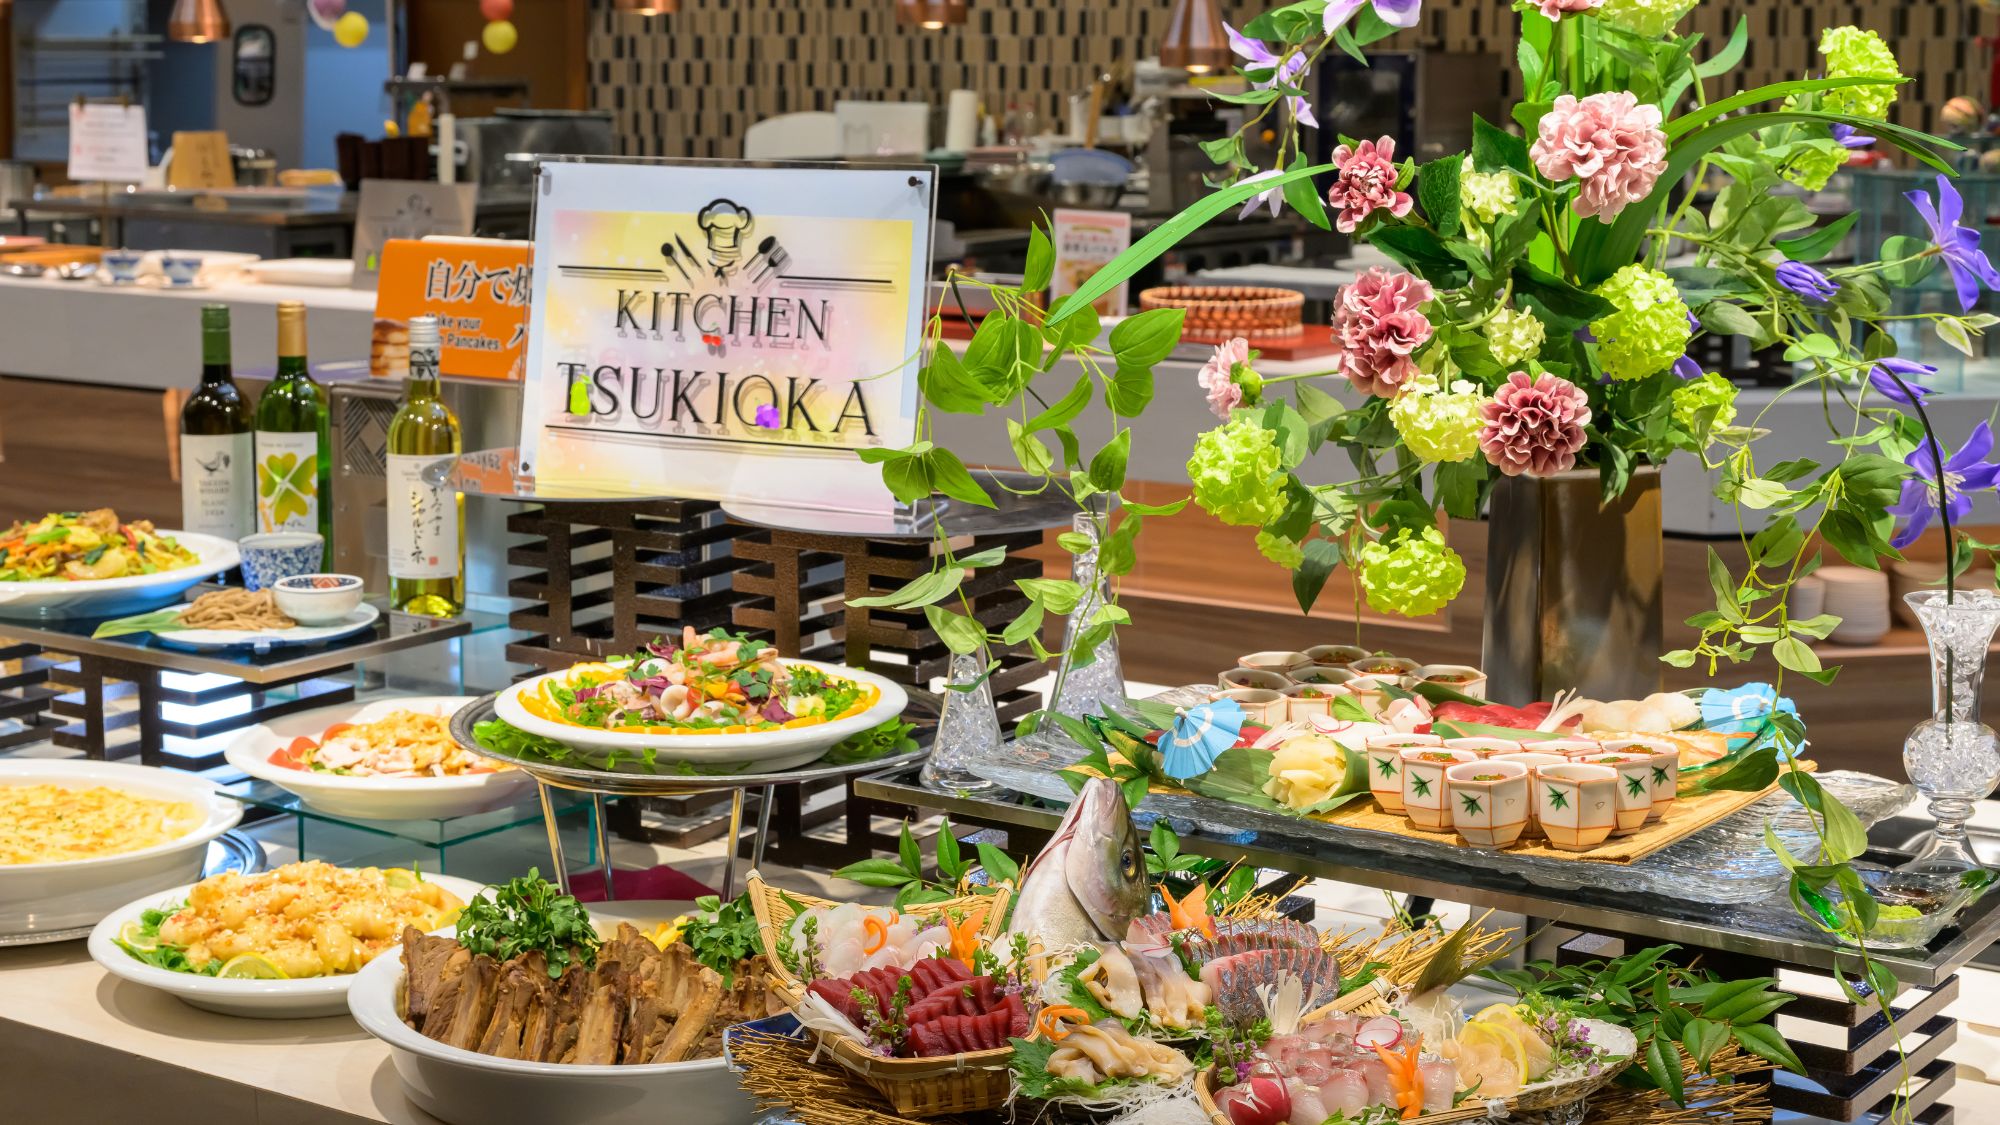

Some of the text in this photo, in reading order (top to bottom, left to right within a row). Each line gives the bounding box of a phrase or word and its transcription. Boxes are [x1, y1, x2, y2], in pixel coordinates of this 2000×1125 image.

[457, 318, 481, 331] your
[614, 289, 830, 342] KITCHEN
[556, 362, 876, 436] TSUKIOKA
[411, 491, 426, 565] シャルドネ
